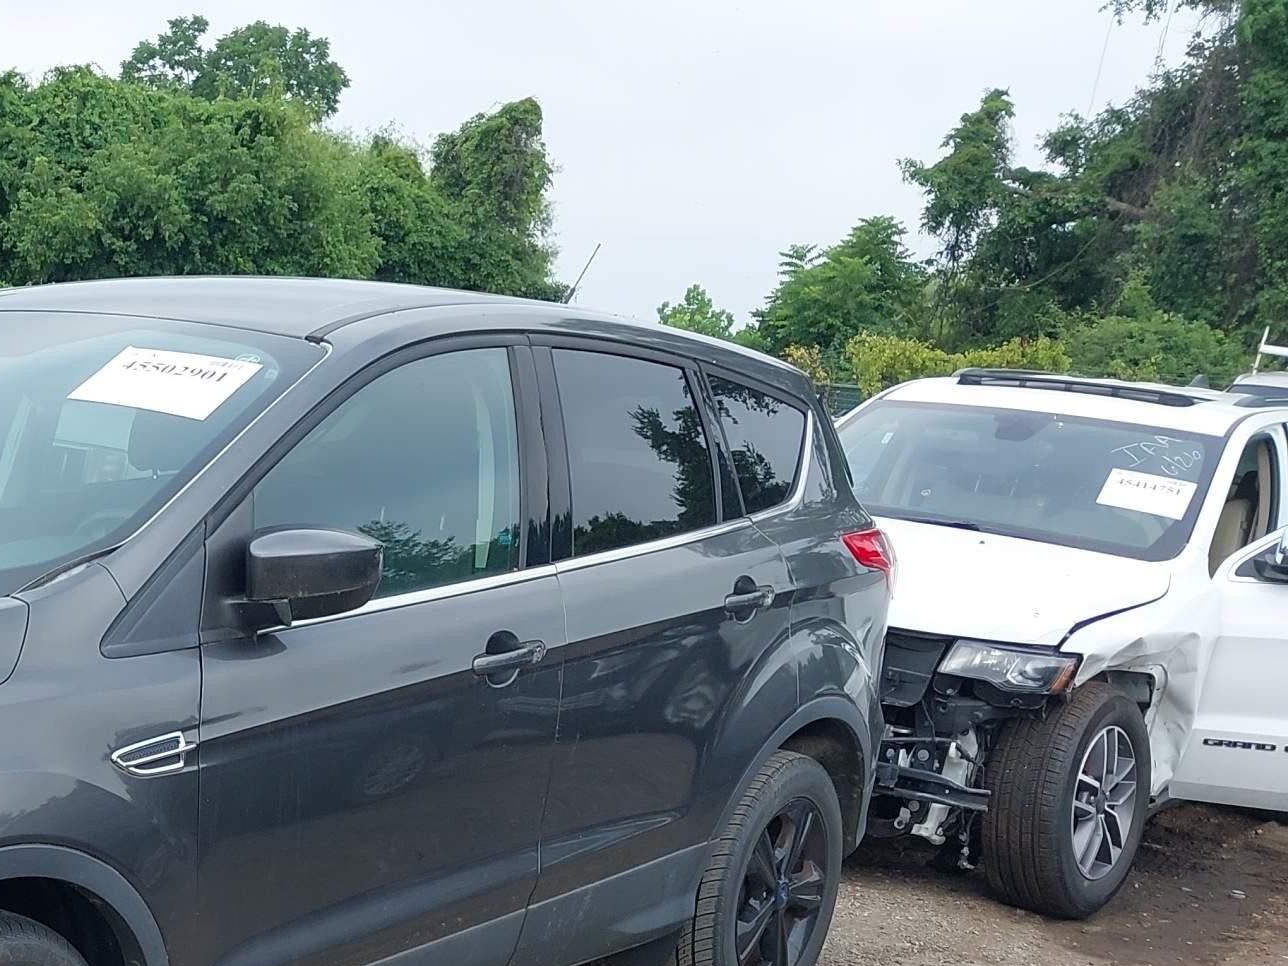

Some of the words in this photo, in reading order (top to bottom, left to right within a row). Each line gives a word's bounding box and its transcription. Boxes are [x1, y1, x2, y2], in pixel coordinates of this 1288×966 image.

[122, 360, 228, 382] 45502901
[1111, 435, 1182, 467] IAA
[1202, 738, 1276, 752] GRAND
